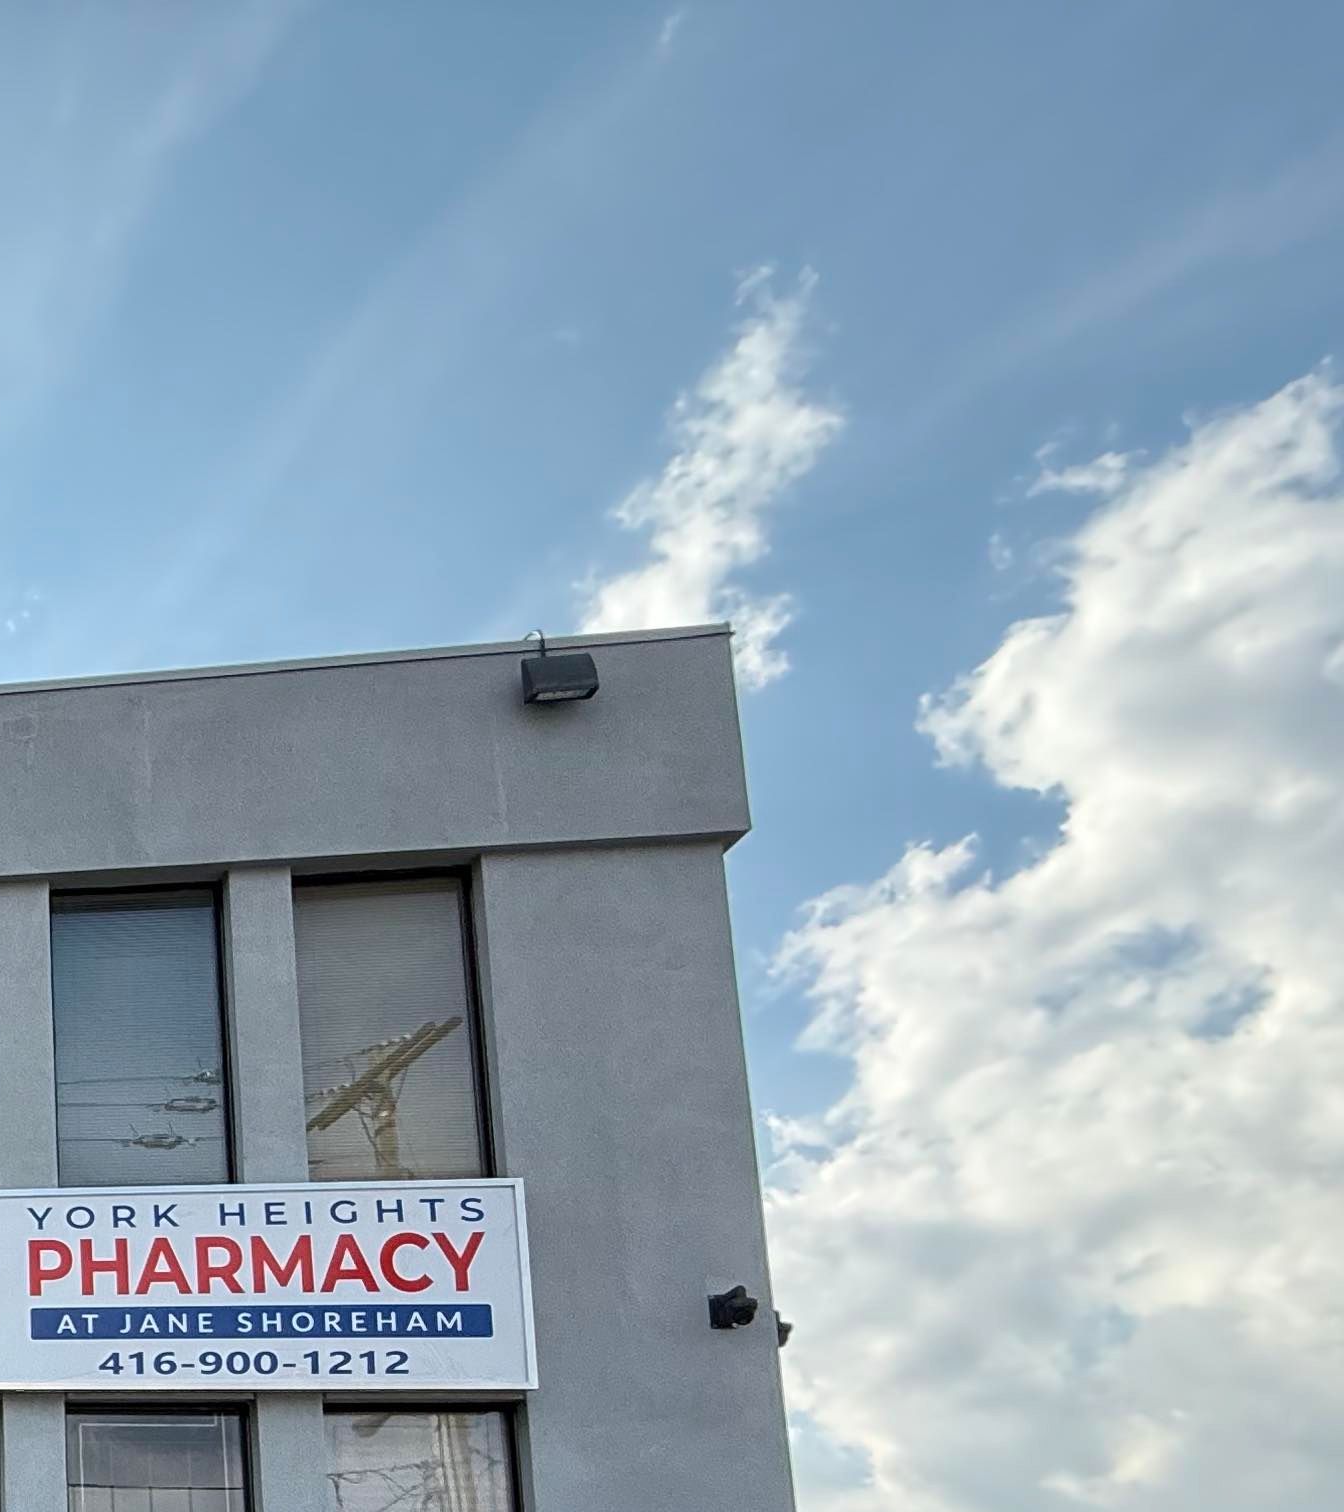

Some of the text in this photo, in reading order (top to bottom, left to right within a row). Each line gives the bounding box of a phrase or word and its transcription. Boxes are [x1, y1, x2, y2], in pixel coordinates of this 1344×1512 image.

[27, 1197, 485, 1230] YORK HEIGHTS
[28, 1231, 483, 1296] PHARMACY
[56, 1311, 463, 1334] AT JANE SHOREHAM
[98, 1350, 410, 1375] 416-900-1212
